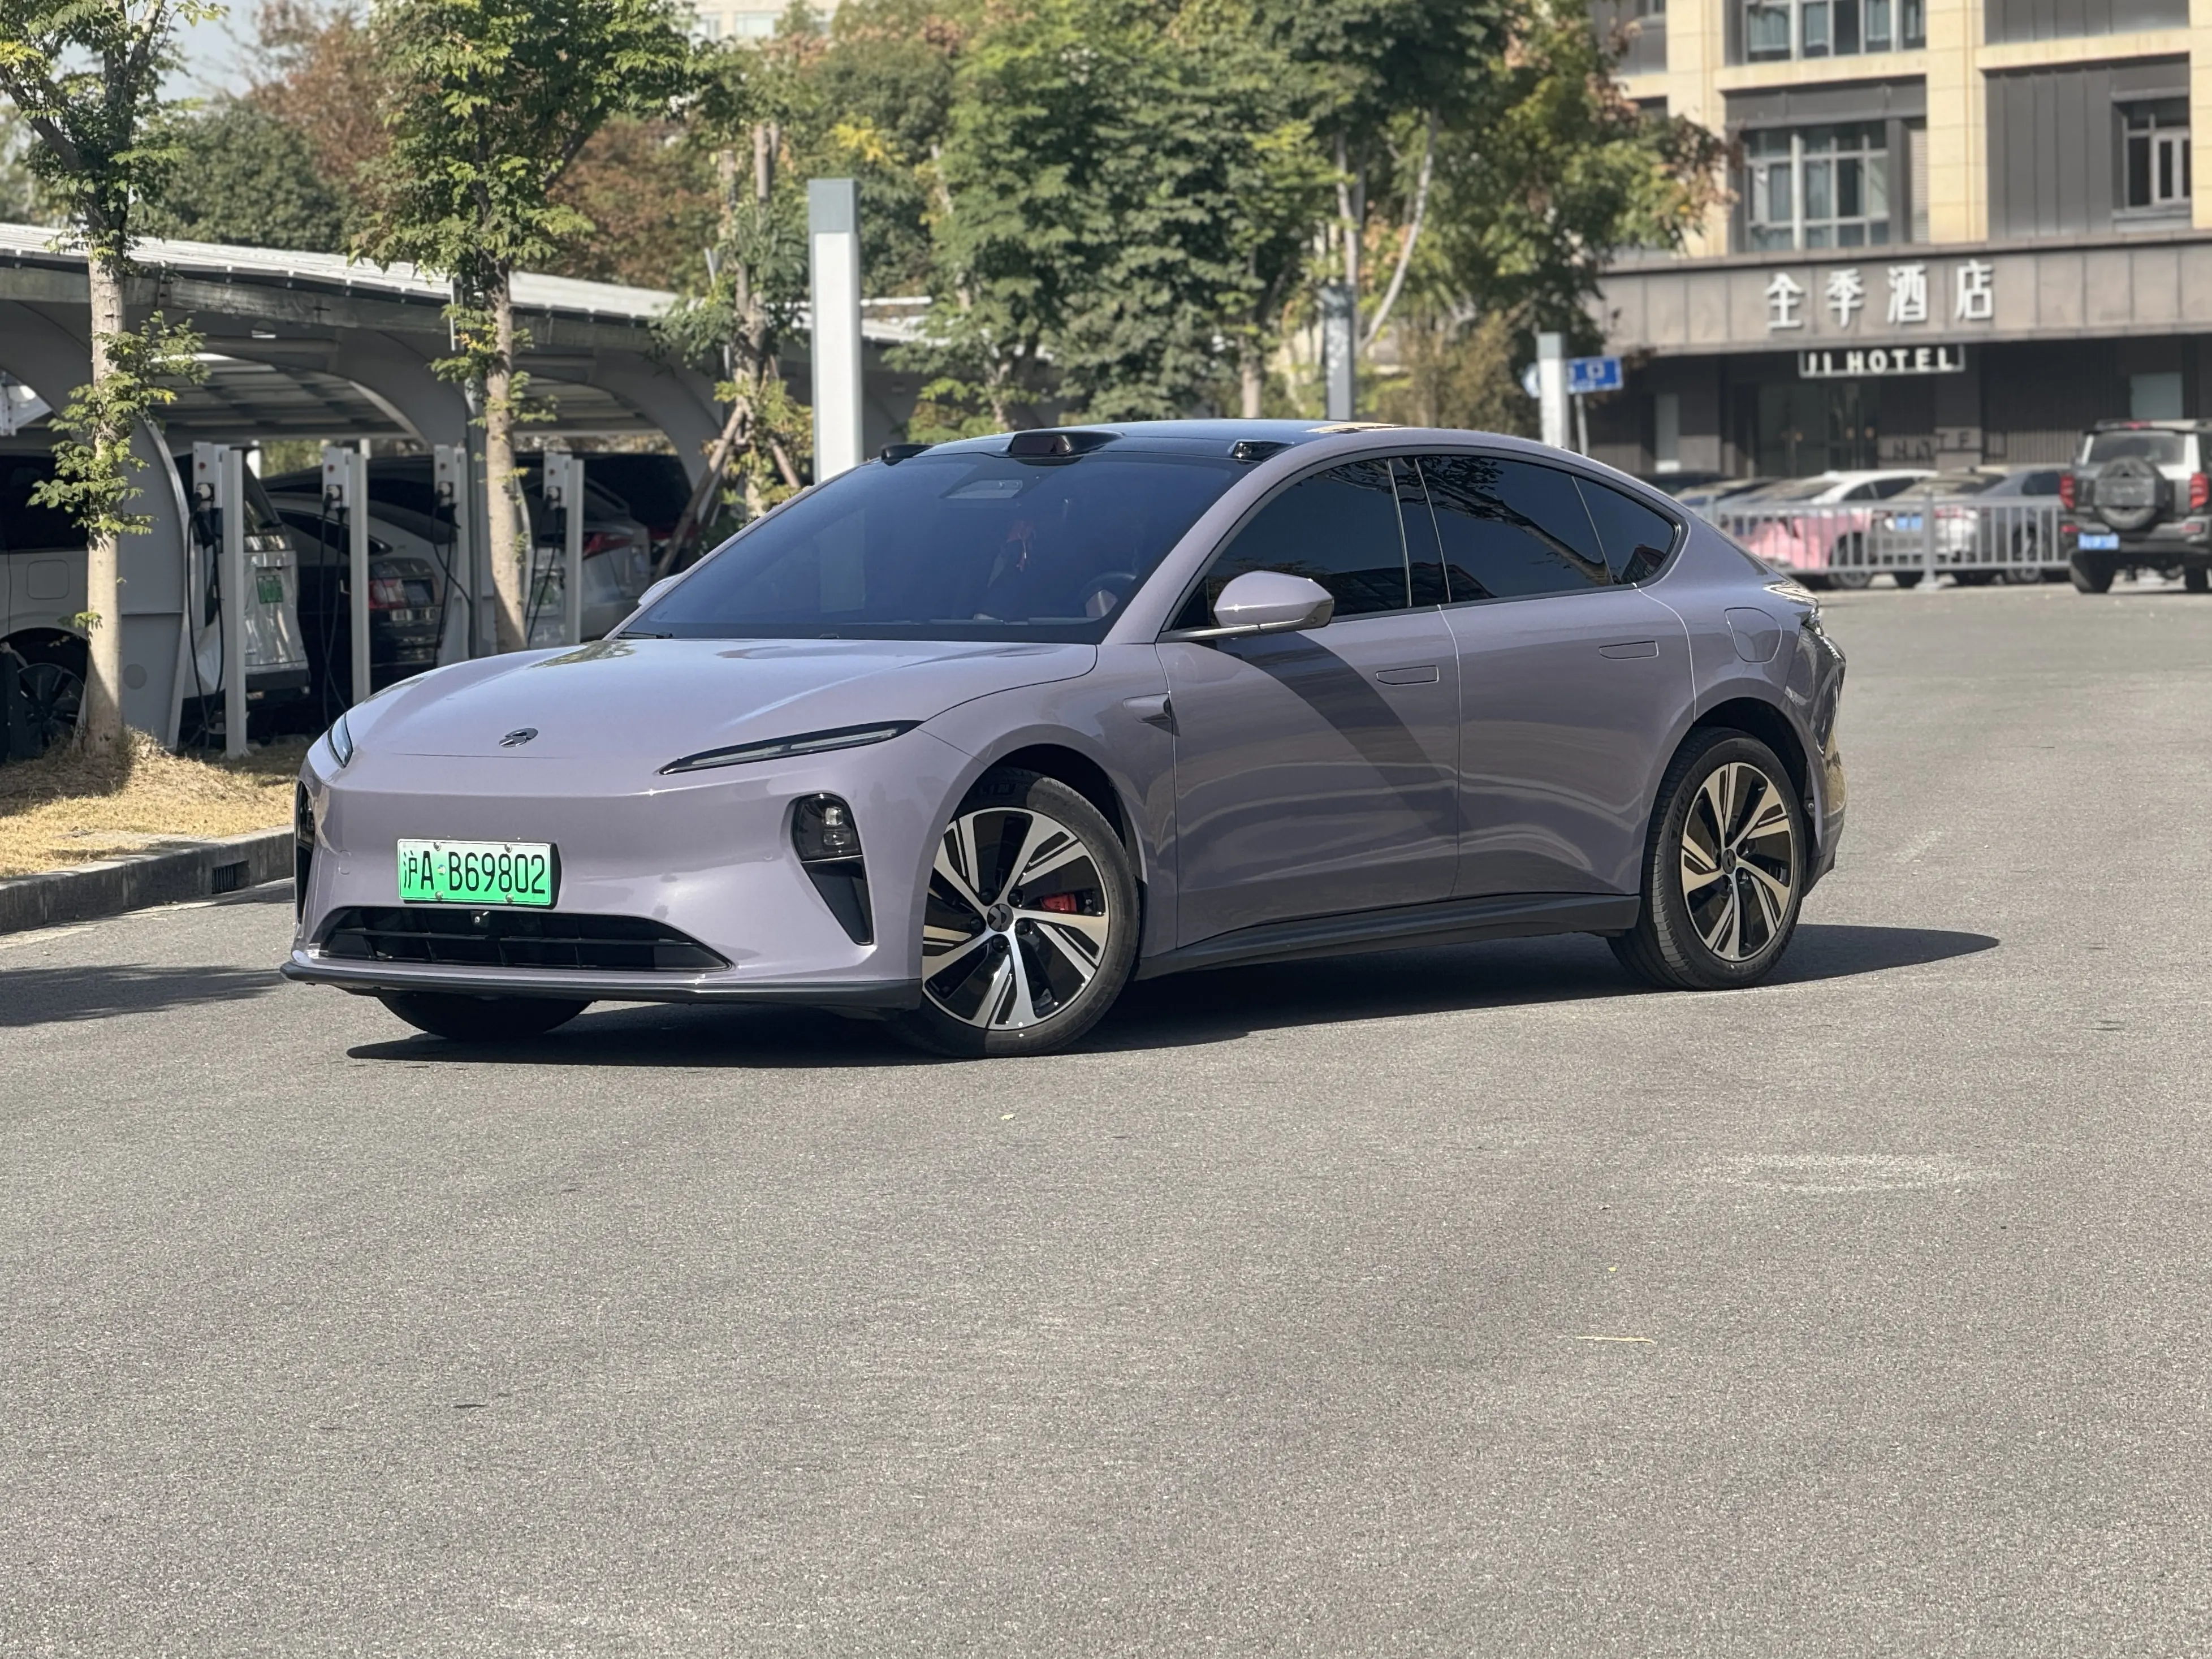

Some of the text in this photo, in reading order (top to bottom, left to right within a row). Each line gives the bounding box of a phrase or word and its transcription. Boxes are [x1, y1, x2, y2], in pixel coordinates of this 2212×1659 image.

[1765, 259, 1993, 330] 全季酒店
[1808, 347, 1954, 378] JI HOTEL
